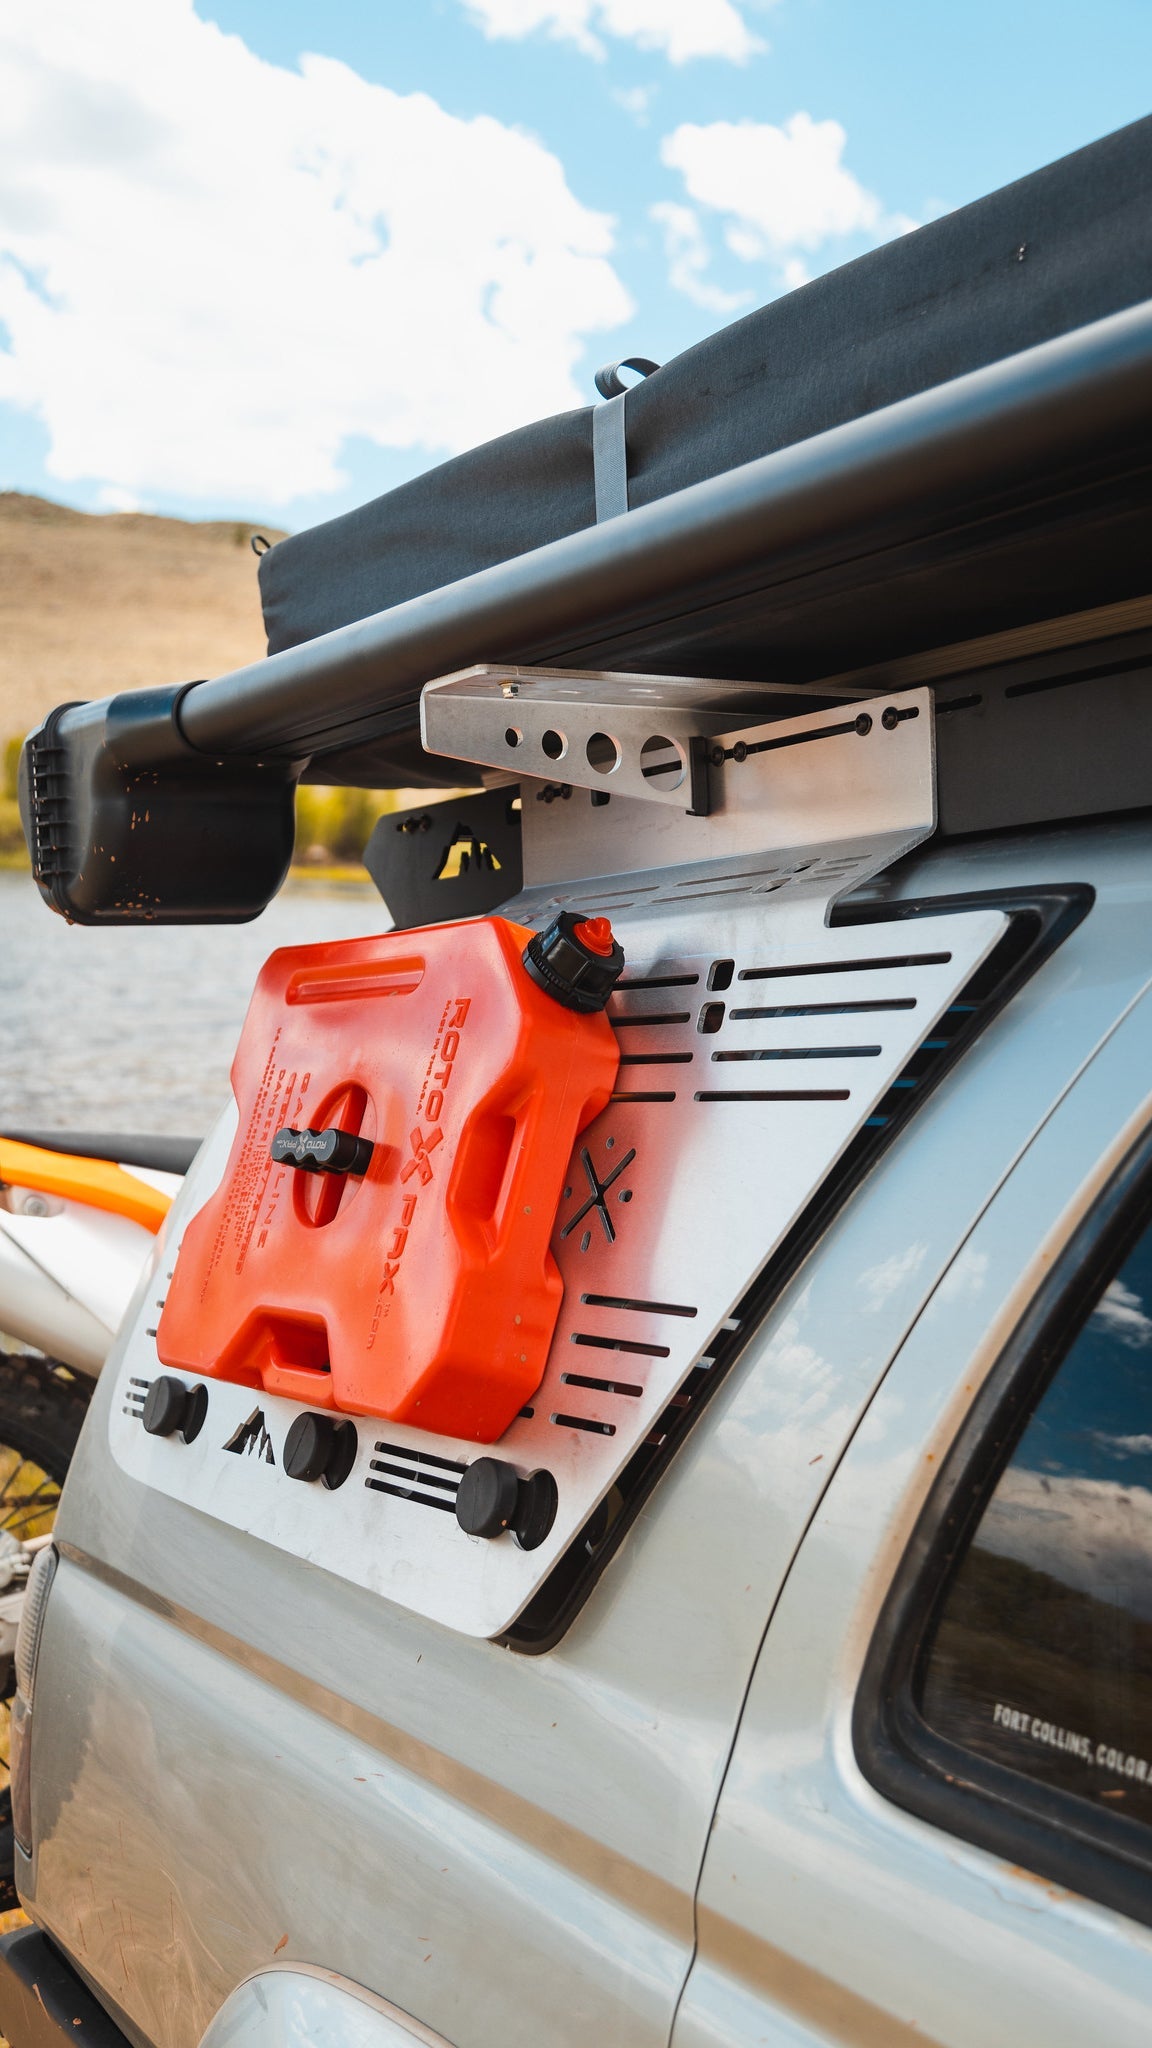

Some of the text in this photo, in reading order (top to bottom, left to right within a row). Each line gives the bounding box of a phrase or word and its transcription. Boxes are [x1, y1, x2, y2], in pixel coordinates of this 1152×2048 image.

[438, 999, 452, 1034] MADE
[425, 998, 471, 1122] ROTO
[427, 1053, 436, 1077] THE
[261, 1068, 287, 1142] DANGER
[379, 1194, 417, 1296] PAX
[993, 1703, 1030, 1733] FORT
[1030, 1717, 1094, 1765] COLLINS,
